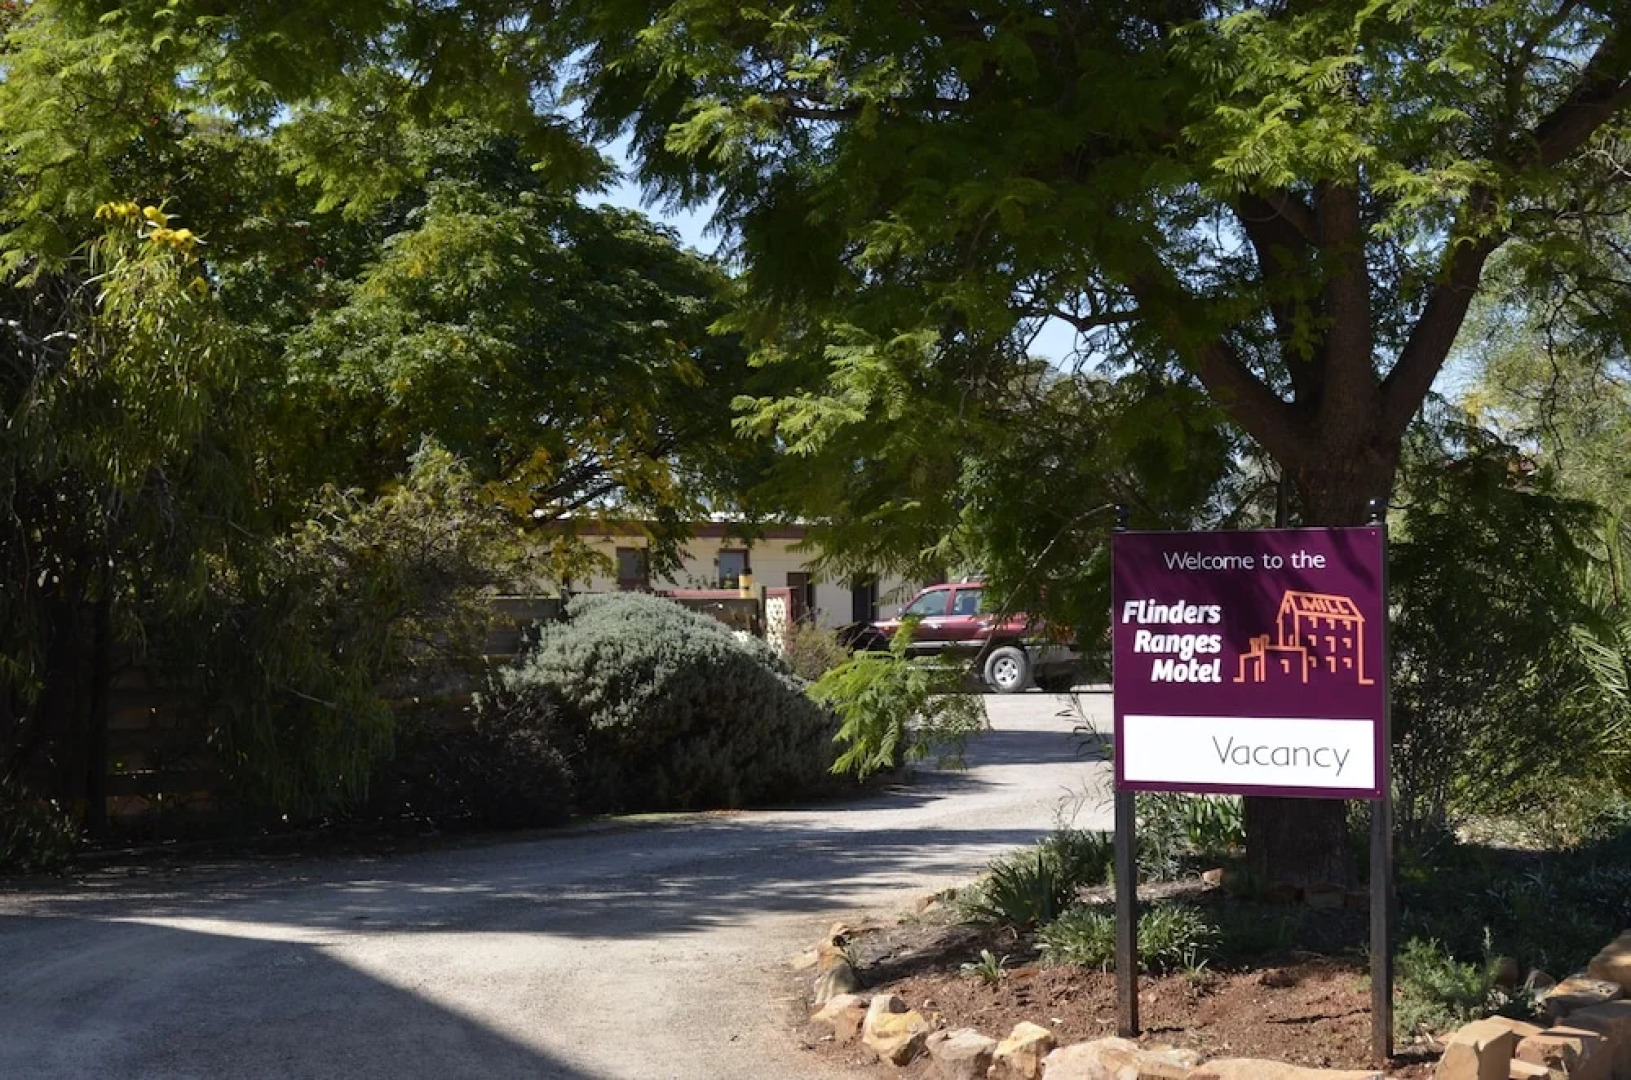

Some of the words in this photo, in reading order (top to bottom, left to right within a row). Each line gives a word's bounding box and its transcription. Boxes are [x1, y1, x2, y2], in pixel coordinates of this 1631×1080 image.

[1163, 551, 1254, 570] Welcome
[1262, 553, 1283, 570] to
[1291, 550, 1326, 569] the
[1122, 598, 1222, 625] Flinders
[1301, 595, 1349, 614] MILL
[1134, 629, 1222, 660] Ranges
[1151, 657, 1222, 684] Motel
[1212, 735, 1350, 777] Vacancy
